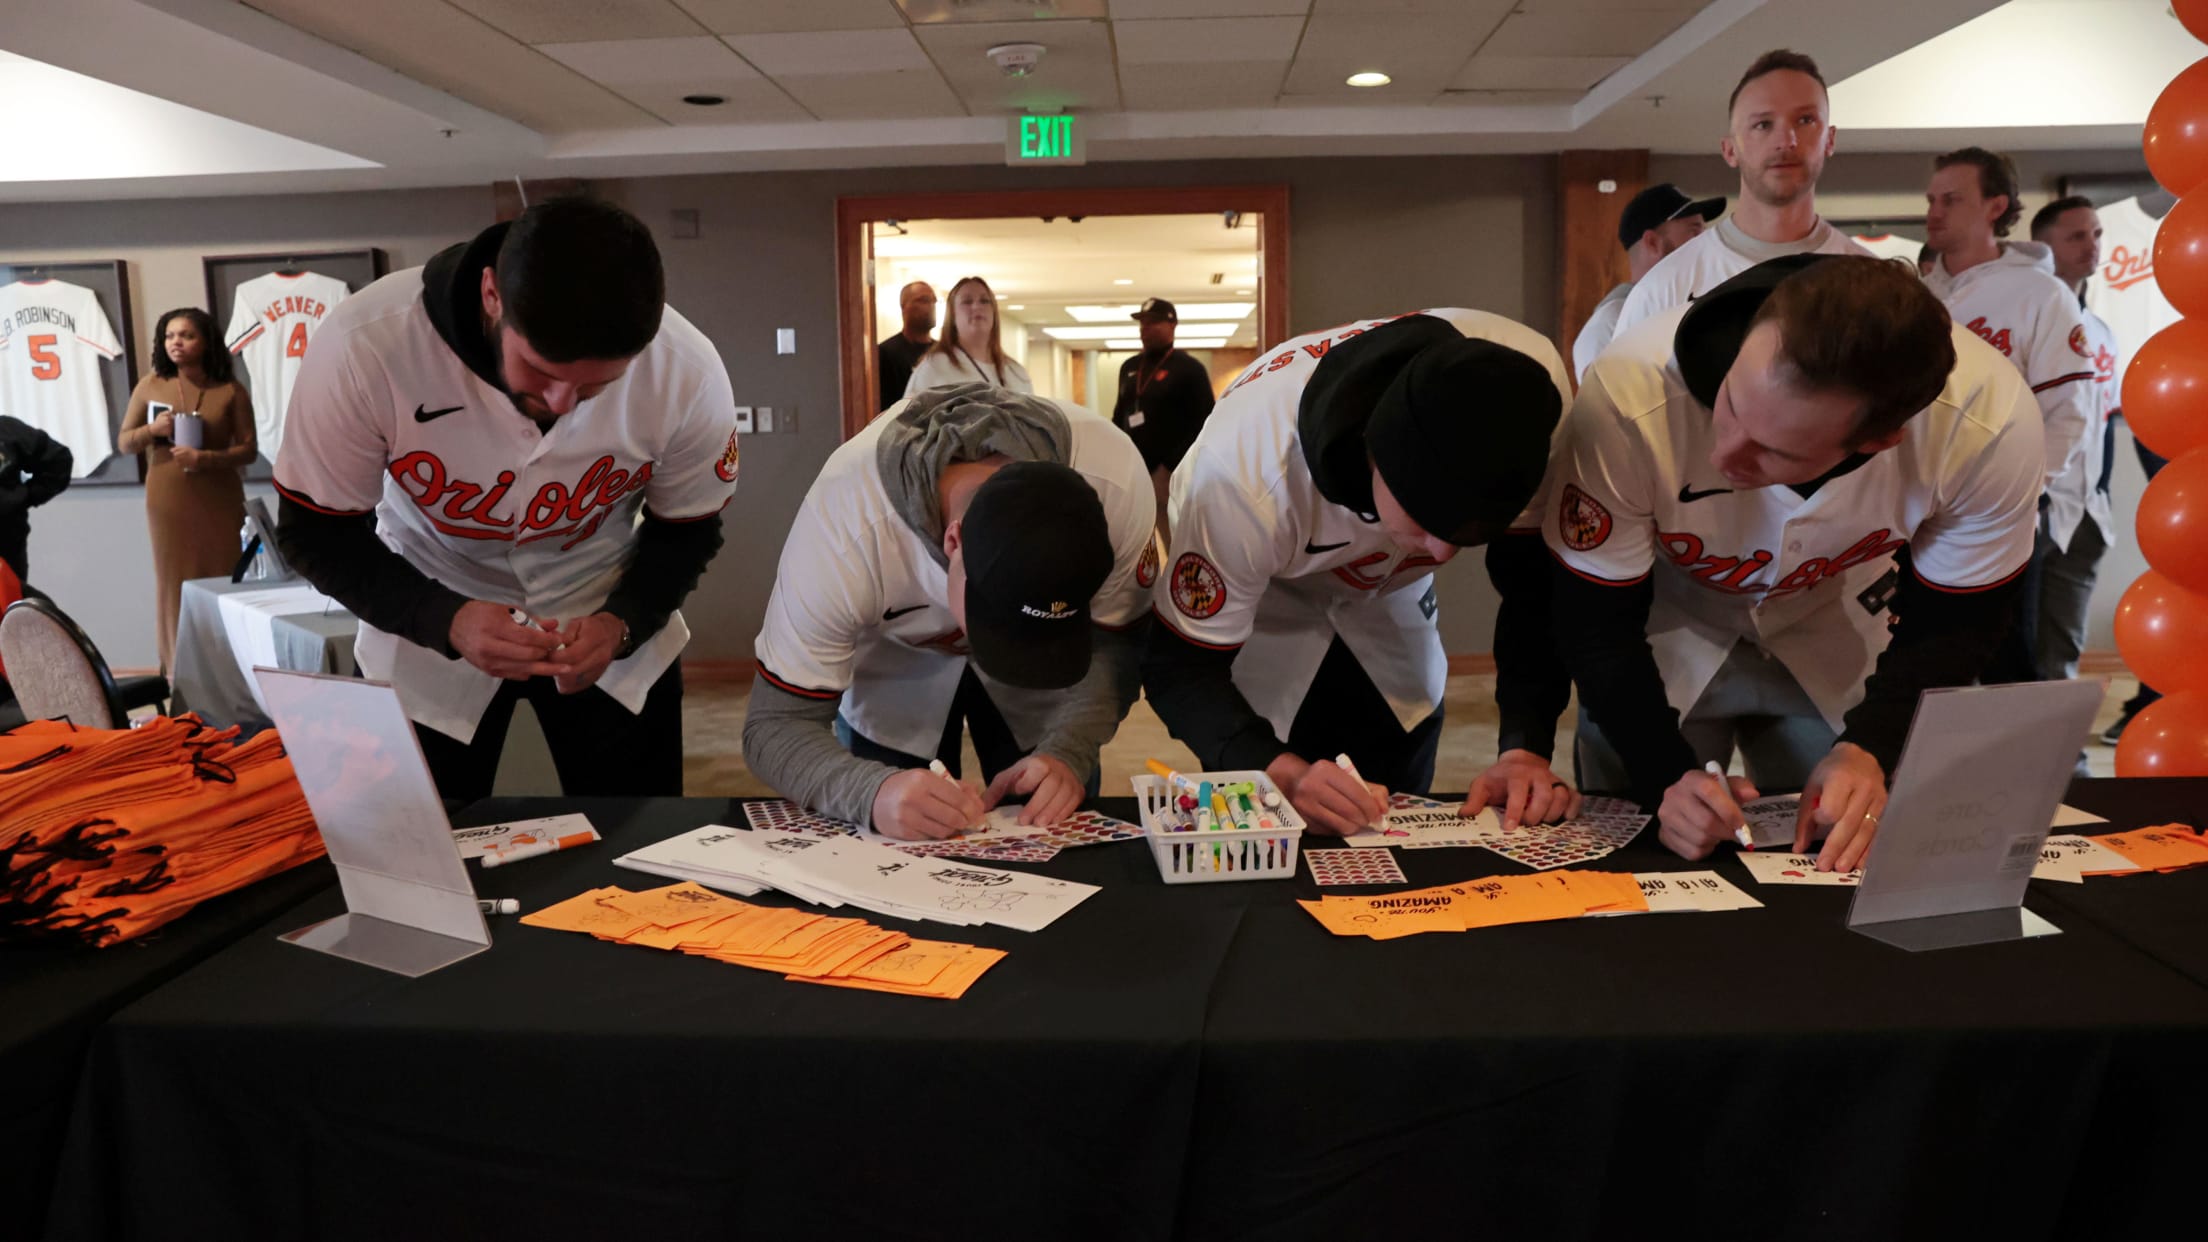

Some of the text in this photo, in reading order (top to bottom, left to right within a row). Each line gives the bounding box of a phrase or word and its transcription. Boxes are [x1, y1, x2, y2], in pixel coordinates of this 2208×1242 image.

[1020, 116, 1074, 158] EXIT
[15, 306, 76, 333] ROBINSON
[263, 296, 325, 323] WEAVER
[28, 334, 61, 380] 5
[286, 322, 308, 358] 4
[389, 451, 654, 532] Orioles
[1369, 895, 1452, 909] AMAZING
